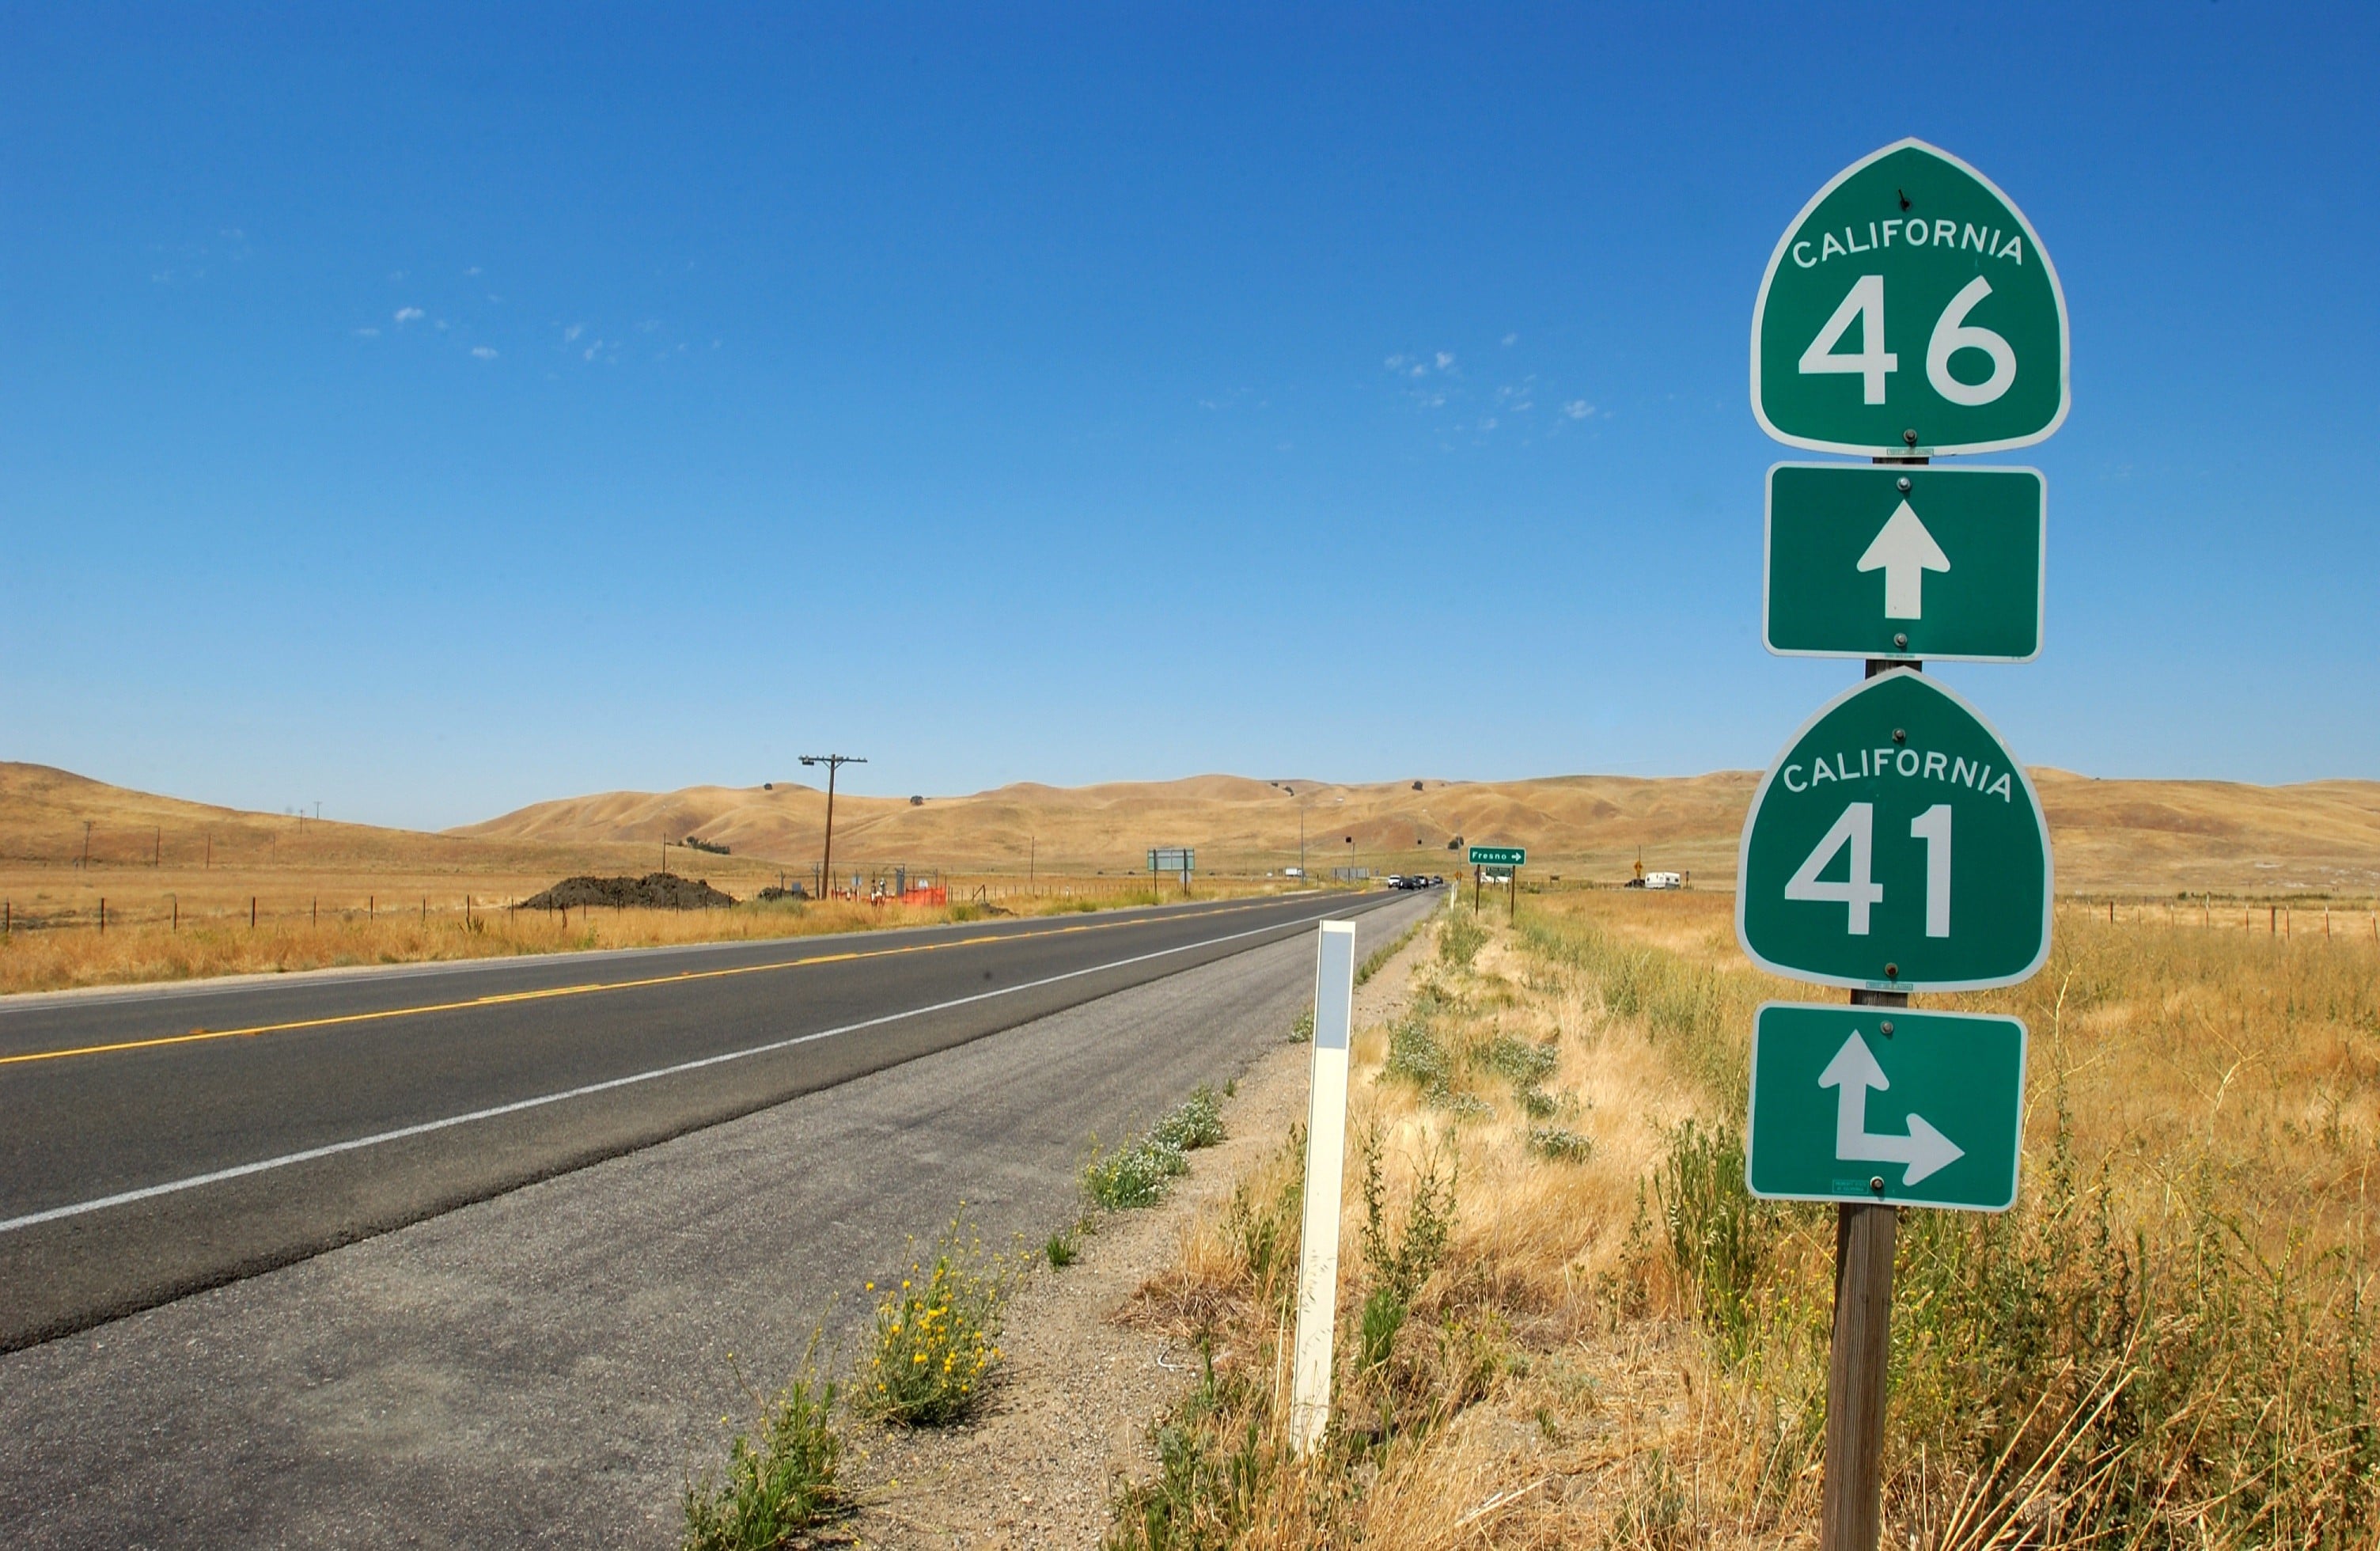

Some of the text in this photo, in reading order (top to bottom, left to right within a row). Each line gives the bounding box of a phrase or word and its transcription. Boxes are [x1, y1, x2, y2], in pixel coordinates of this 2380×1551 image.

[1792, 218, 2023, 268] CALIFORNIA
[1798, 274, 2017, 407] 46
[1783, 748, 2011, 803] CALIFORNIA
[1472, 851, 1507, 860] Fresno
[1784, 802, 1952, 938] 41
